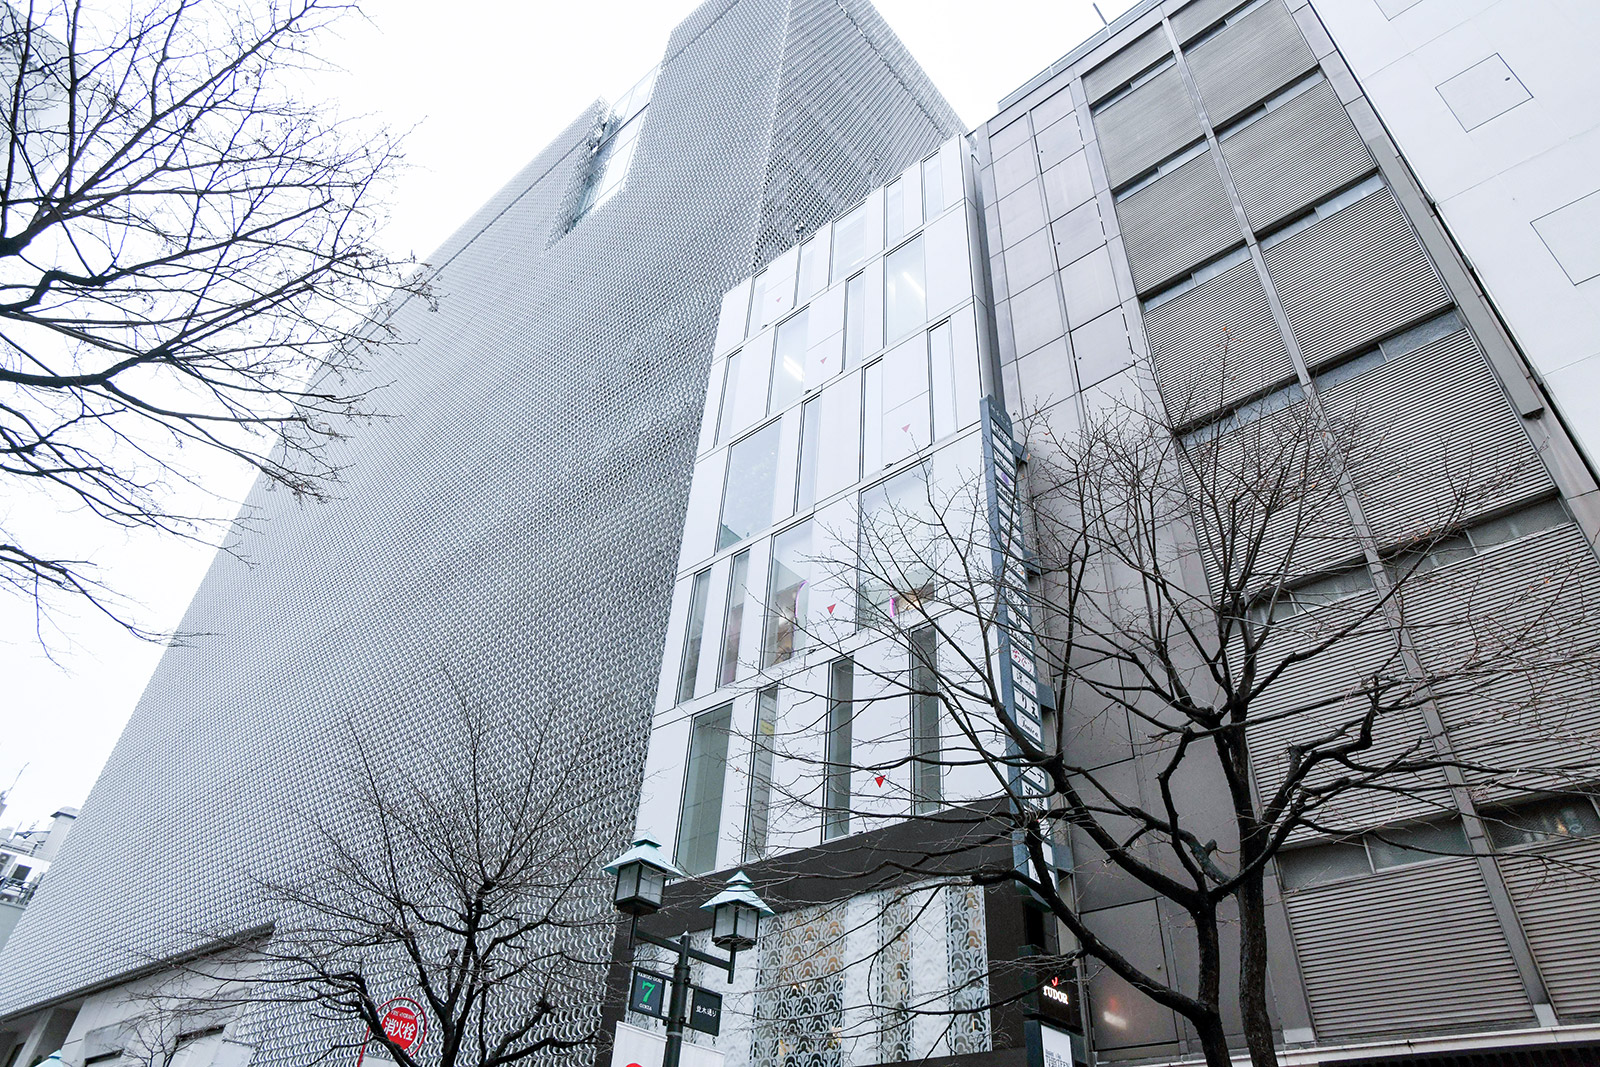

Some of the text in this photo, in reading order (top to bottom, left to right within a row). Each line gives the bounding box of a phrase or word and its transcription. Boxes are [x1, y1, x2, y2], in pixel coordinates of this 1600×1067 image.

[642, 980, 655, 1003] 7
[1043, 985, 1069, 1005] TUDOR
[384, 1017, 416, 1041] 消火栓
